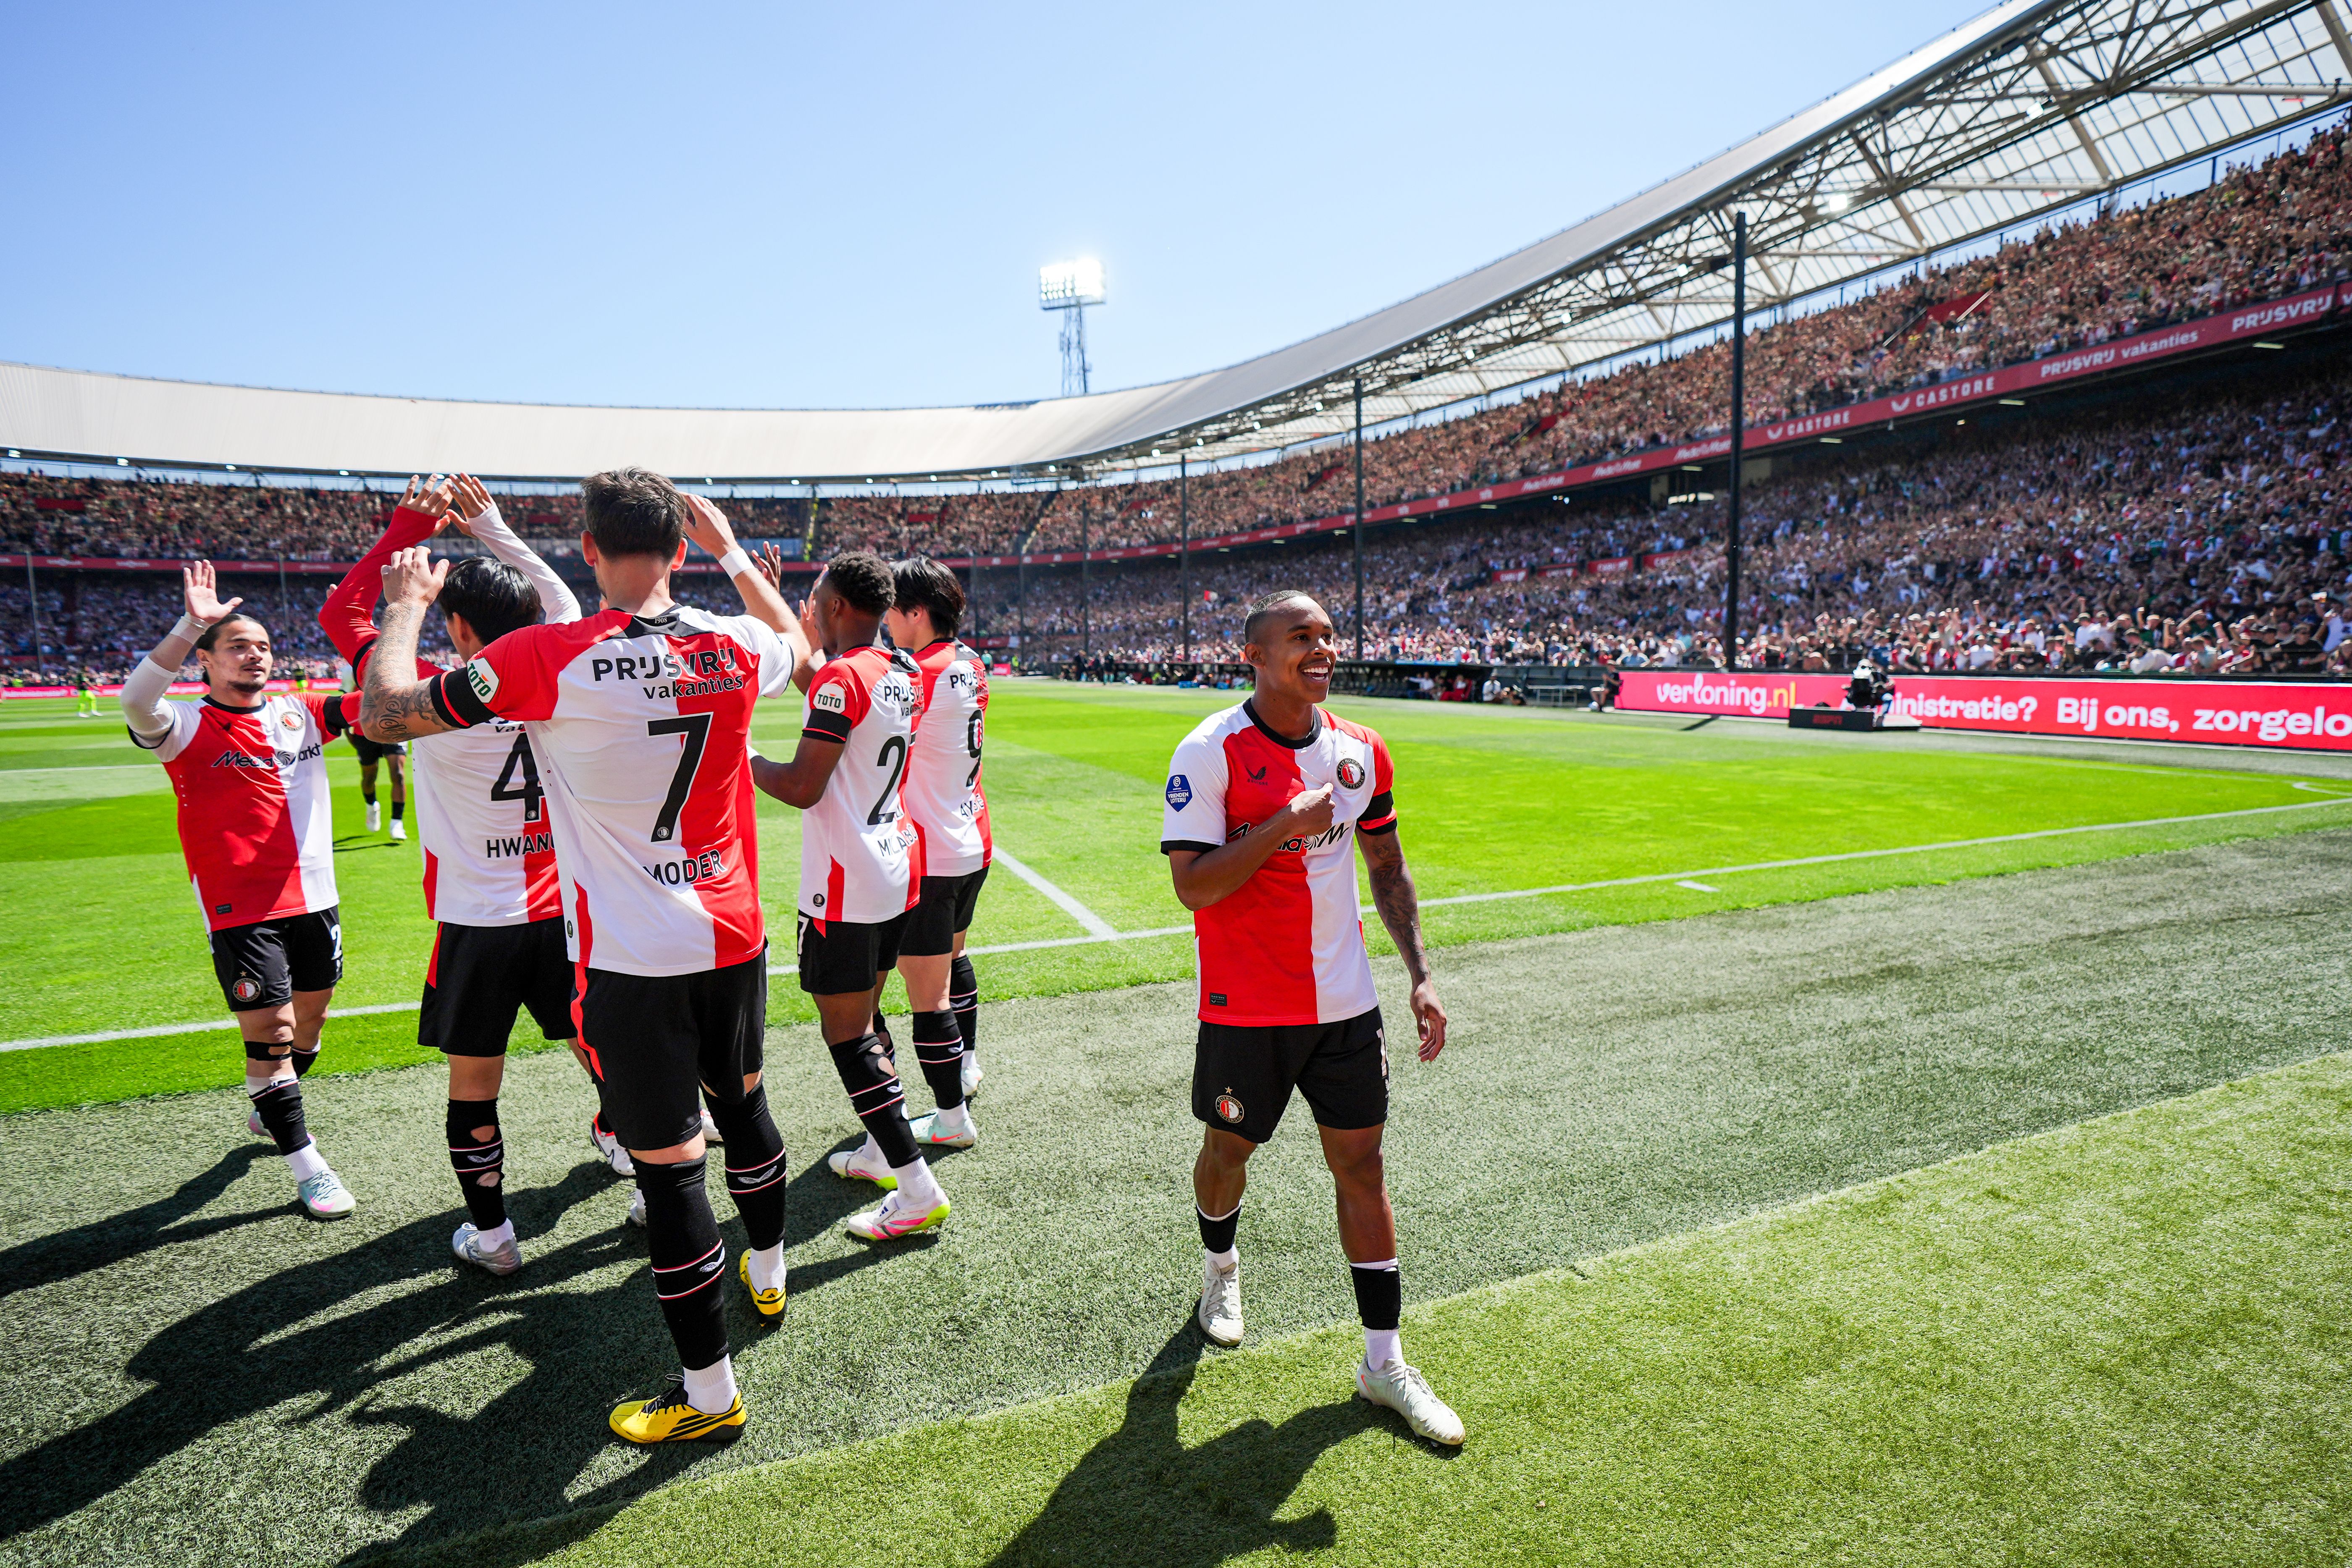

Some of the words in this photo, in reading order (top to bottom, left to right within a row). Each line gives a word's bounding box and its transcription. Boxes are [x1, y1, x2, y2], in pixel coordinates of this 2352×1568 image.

[2121, 330, 2198, 358] vakanties
[1916, 377, 1995, 407] CASTORE
[1787, 412, 1850, 435] CASTORE
[468, 663, 491, 696] TOTO
[643, 675, 743, 699] vakanties
[1656, 673, 1796, 715] verloning.nl
[818, 694, 841, 708] TOTO
[2057, 697, 2099, 732] Bij
[2105, 705, 2179, 733] ons,
[2192, 706, 2352, 742] zorgelo
[966, 709, 983, 787] 9
[491, 732, 545, 822] 4
[648, 712, 714, 842] 7
[1340, 776, 1365, 789] ROTTERDAM
[642, 849, 727, 886] MODER
